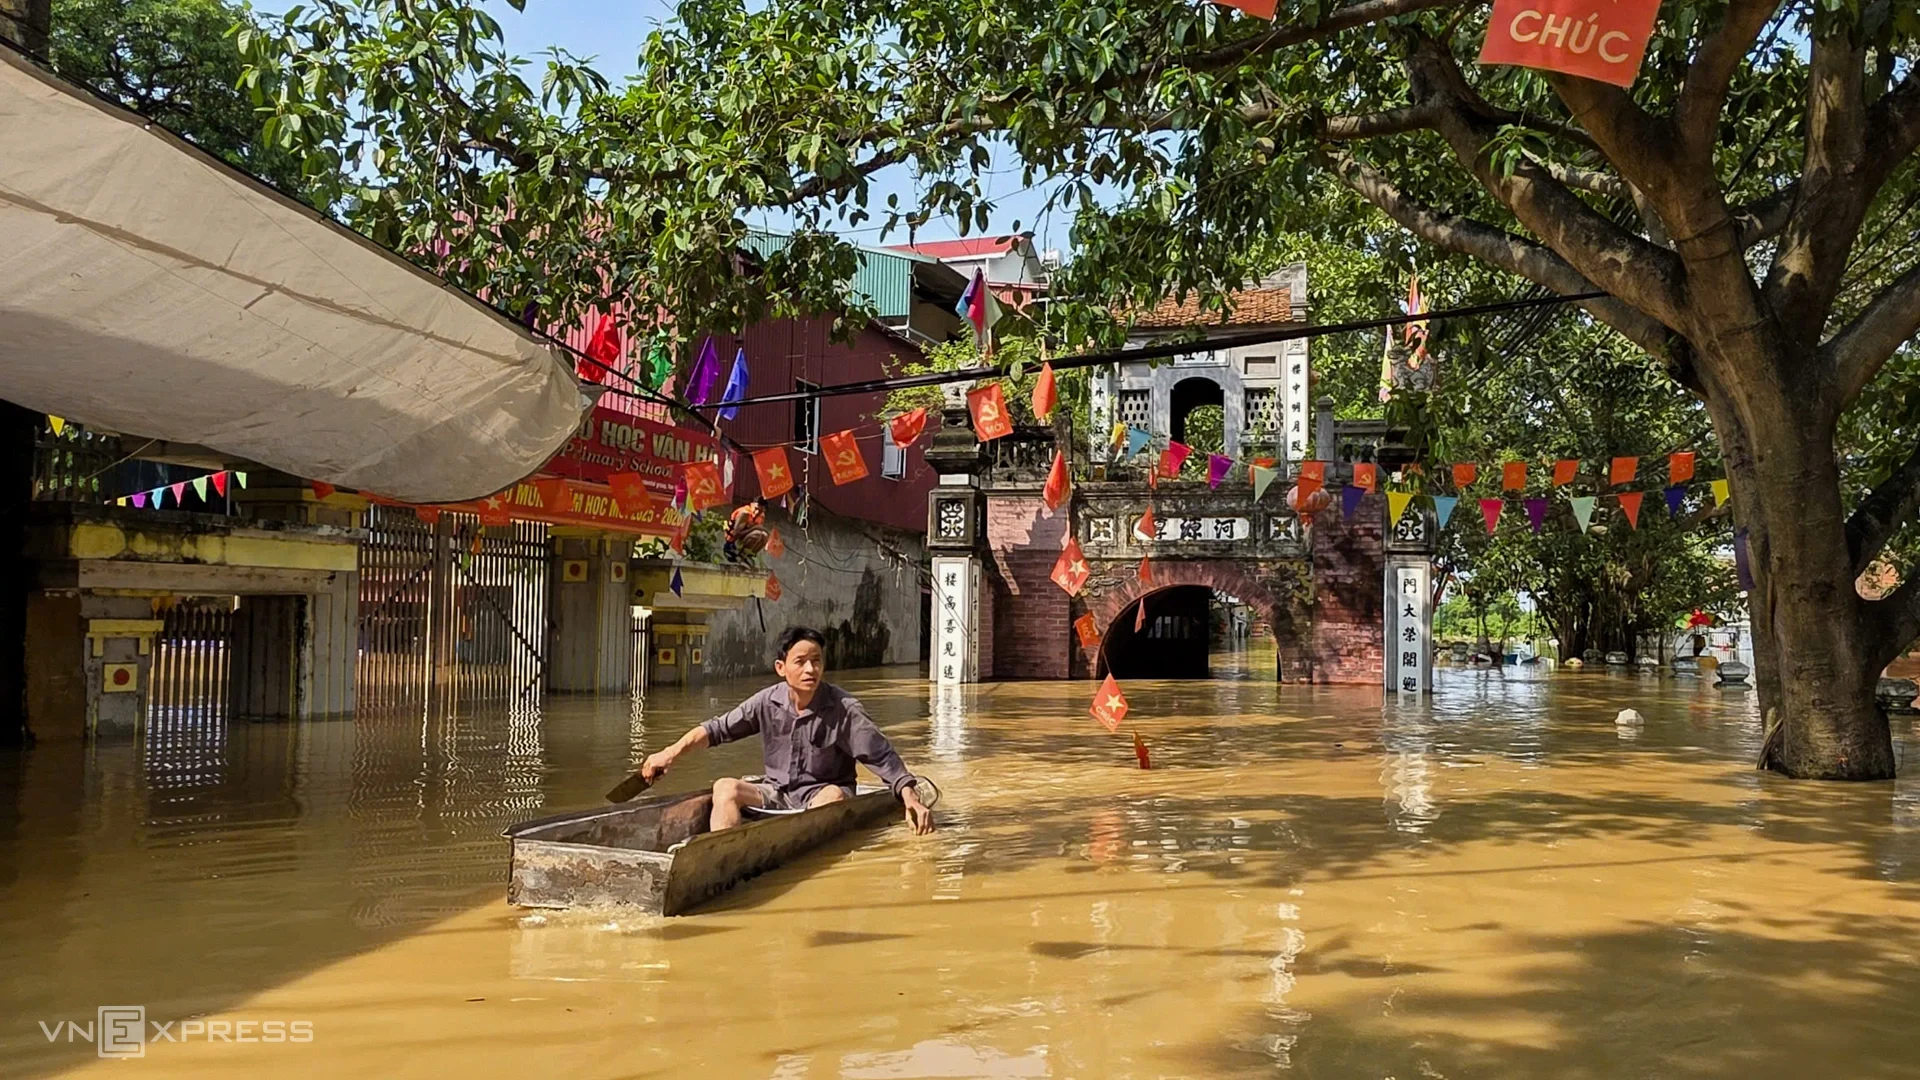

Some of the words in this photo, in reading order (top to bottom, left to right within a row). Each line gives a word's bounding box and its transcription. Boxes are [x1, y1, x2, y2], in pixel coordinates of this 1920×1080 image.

[1509, 10, 1631, 63] CHÚC
[601, 420, 645, 455] HỌC
[653, 430, 690, 463] VÂN
[630, 457, 674, 479] School
[584, 494, 610, 519] HỌC
